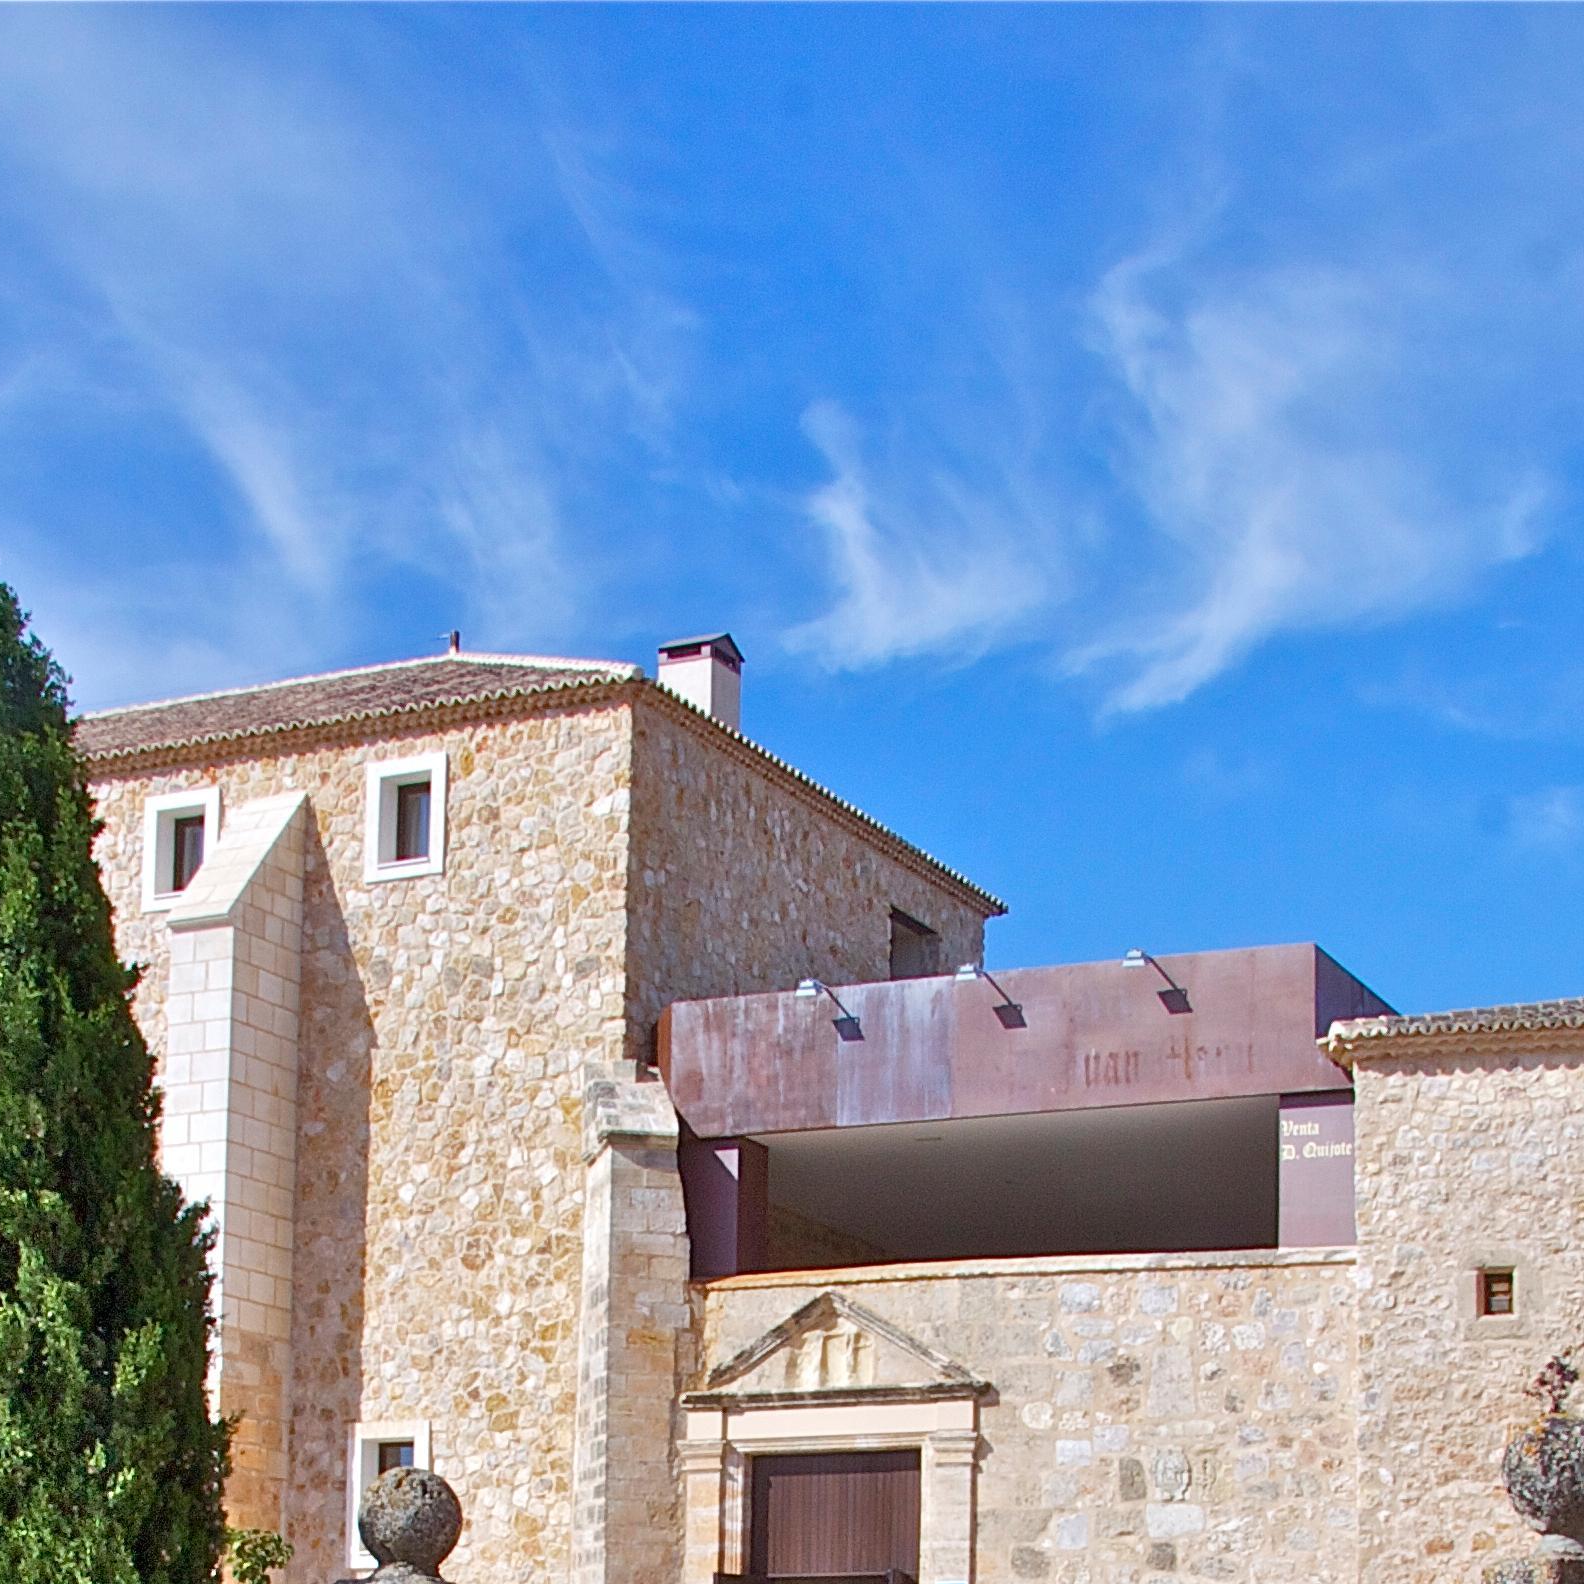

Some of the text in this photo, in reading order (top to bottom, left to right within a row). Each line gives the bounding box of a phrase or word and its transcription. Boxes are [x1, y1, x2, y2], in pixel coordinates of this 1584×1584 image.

[1280, 1120, 1320, 1138] Venta
[1281, 1141, 1353, 1160] D. Quijote
